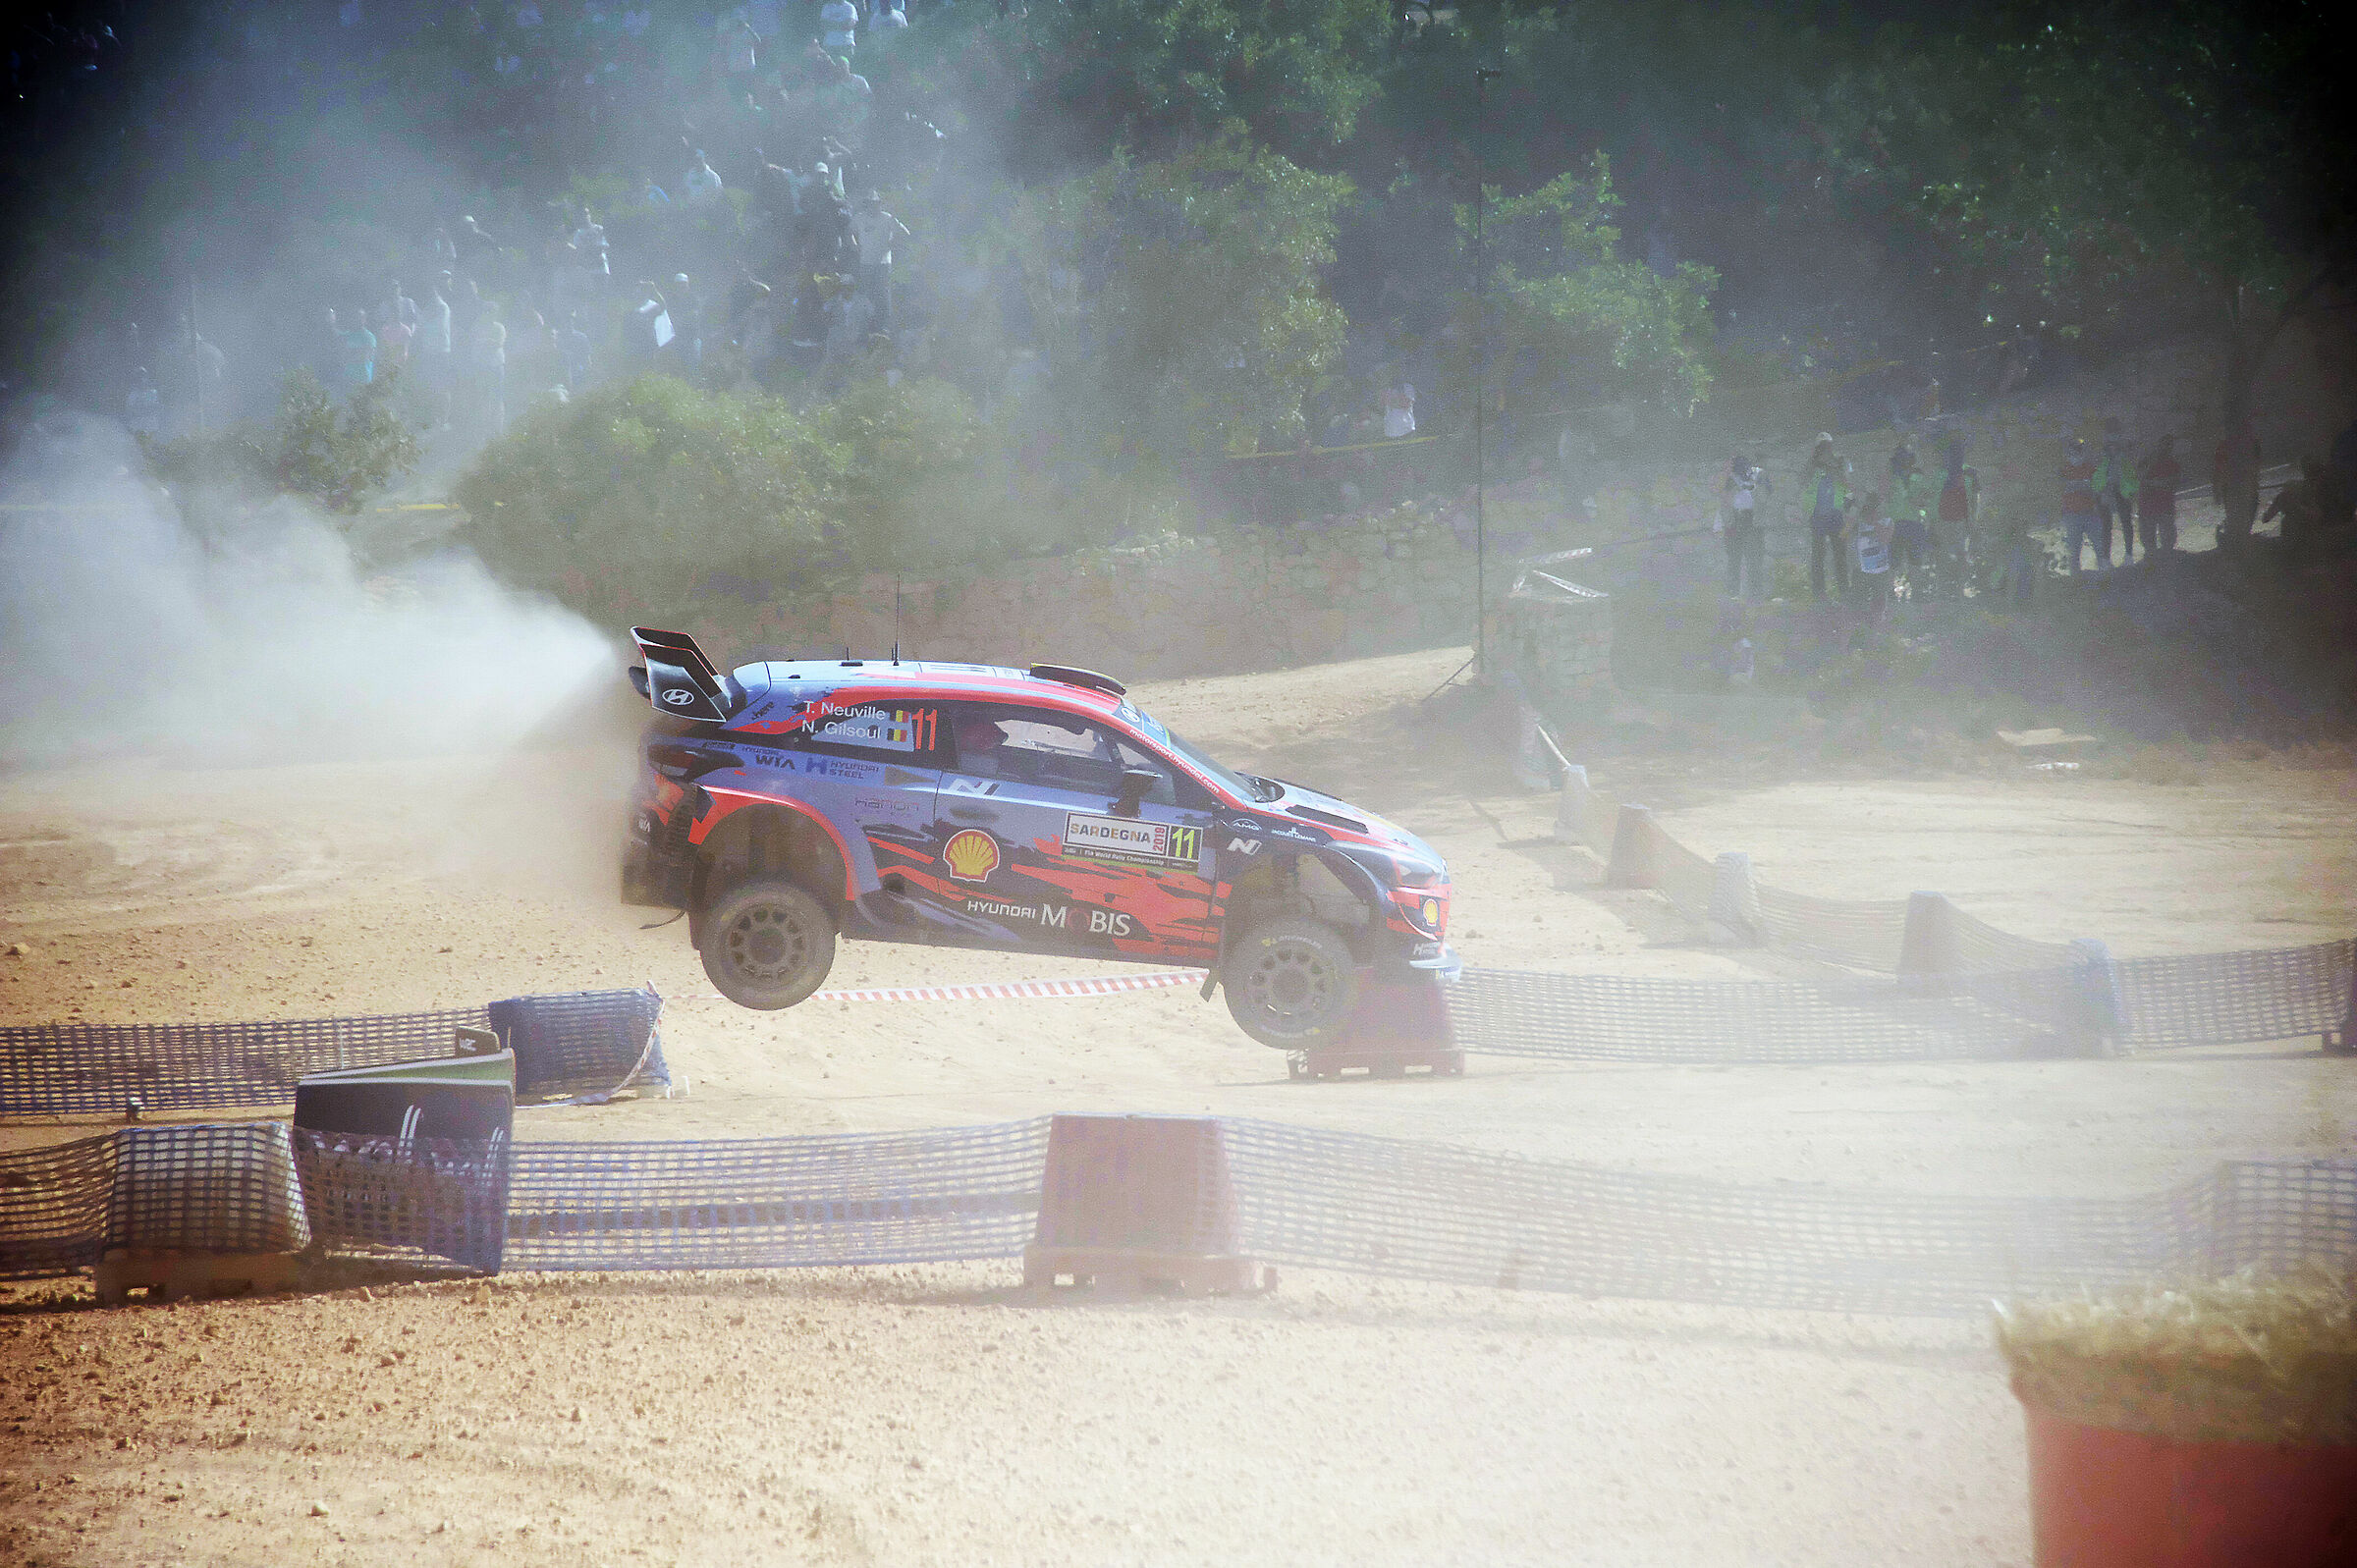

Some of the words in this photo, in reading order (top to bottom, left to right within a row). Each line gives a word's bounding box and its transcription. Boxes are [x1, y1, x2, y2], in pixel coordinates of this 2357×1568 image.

[803, 700, 815, 714] T.
[821, 703, 886, 721] Neuville
[800, 719, 819, 734] N.
[824, 722, 881, 739] Gilsoul
[911, 708, 938, 751] 11
[755, 753, 795, 770] WIA
[830, 761, 880, 773] HYUNDAI
[1128, 729, 1220, 794] motorsport.hyundai.com
[829, 769, 864, 780] STEEL
[1069, 822, 1151, 844] SARDEGNA
[1152, 827, 1166, 852] 2019
[1172, 827, 1195, 859] 11
[966, 900, 1036, 919] HYUNDAI
[1041, 903, 1131, 937] MOBIS
